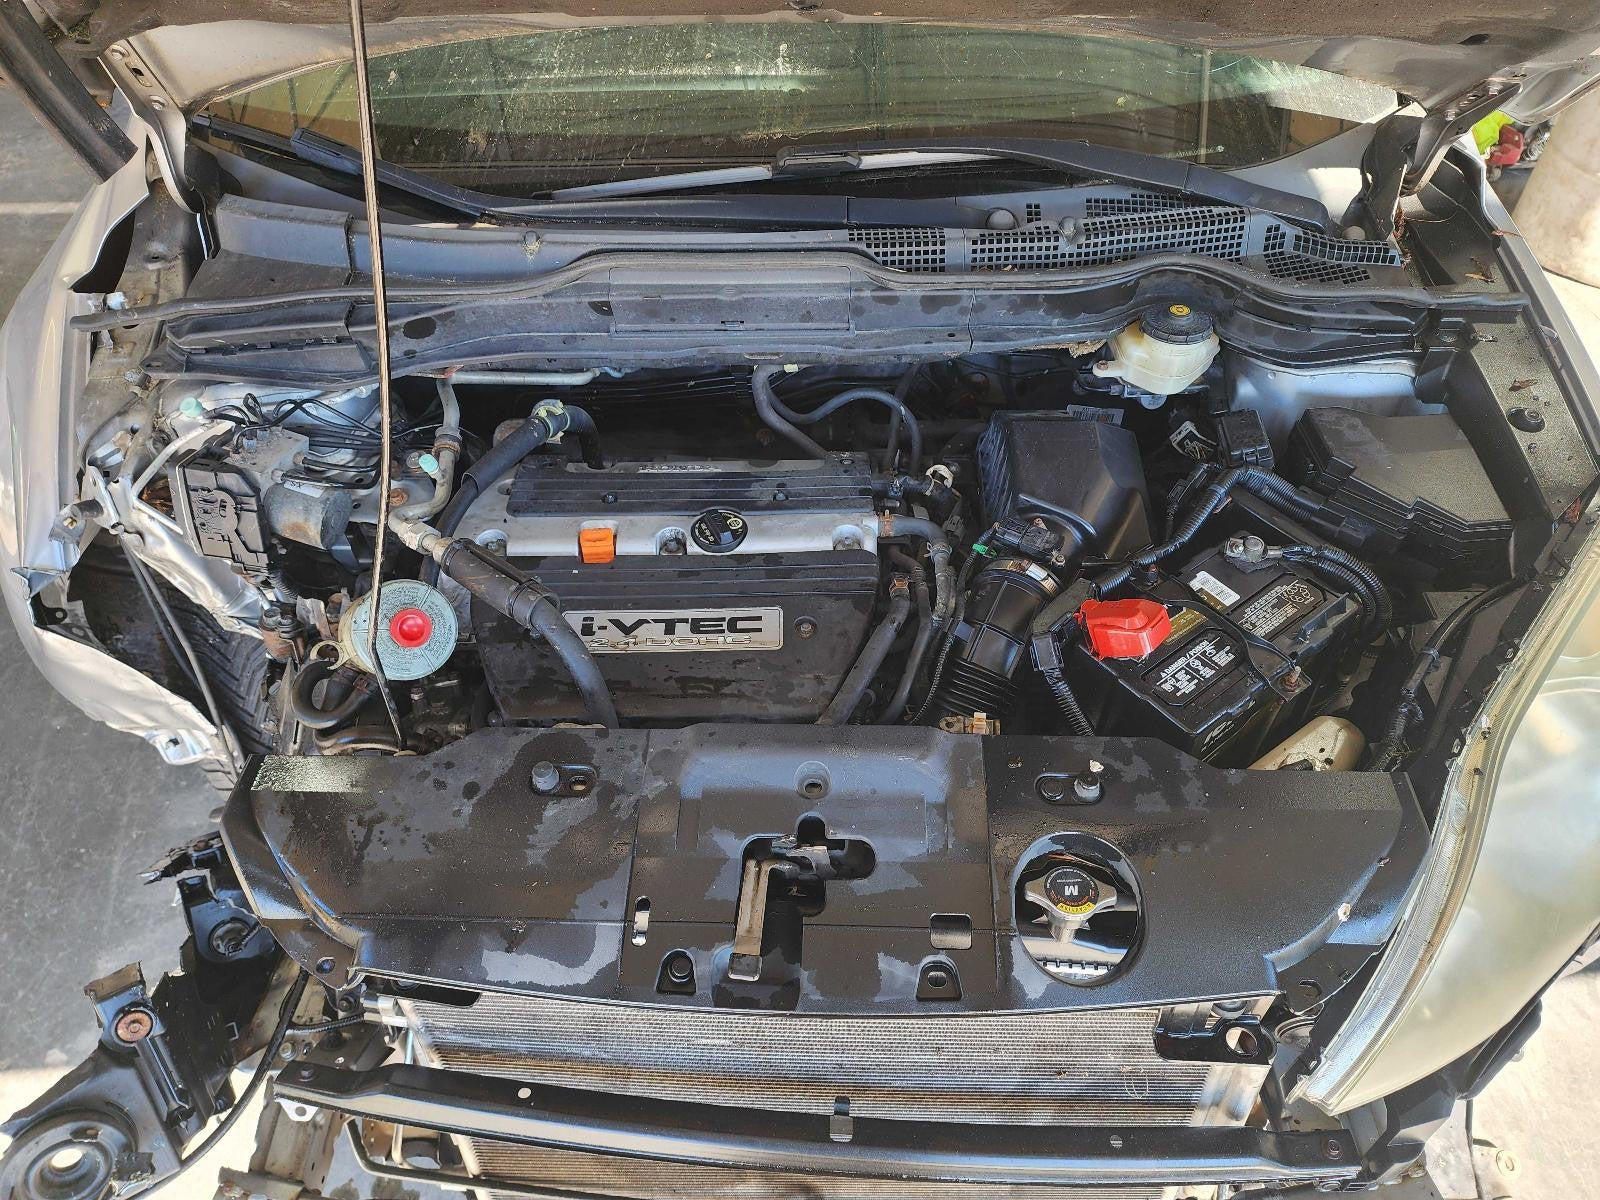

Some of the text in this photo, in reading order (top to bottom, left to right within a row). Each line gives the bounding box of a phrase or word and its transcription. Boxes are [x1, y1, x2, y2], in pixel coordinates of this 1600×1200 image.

[581, 615, 763, 637] i-VTEC
[645, 634, 752, 647] DOHC
[1064, 884, 1079, 896] M
